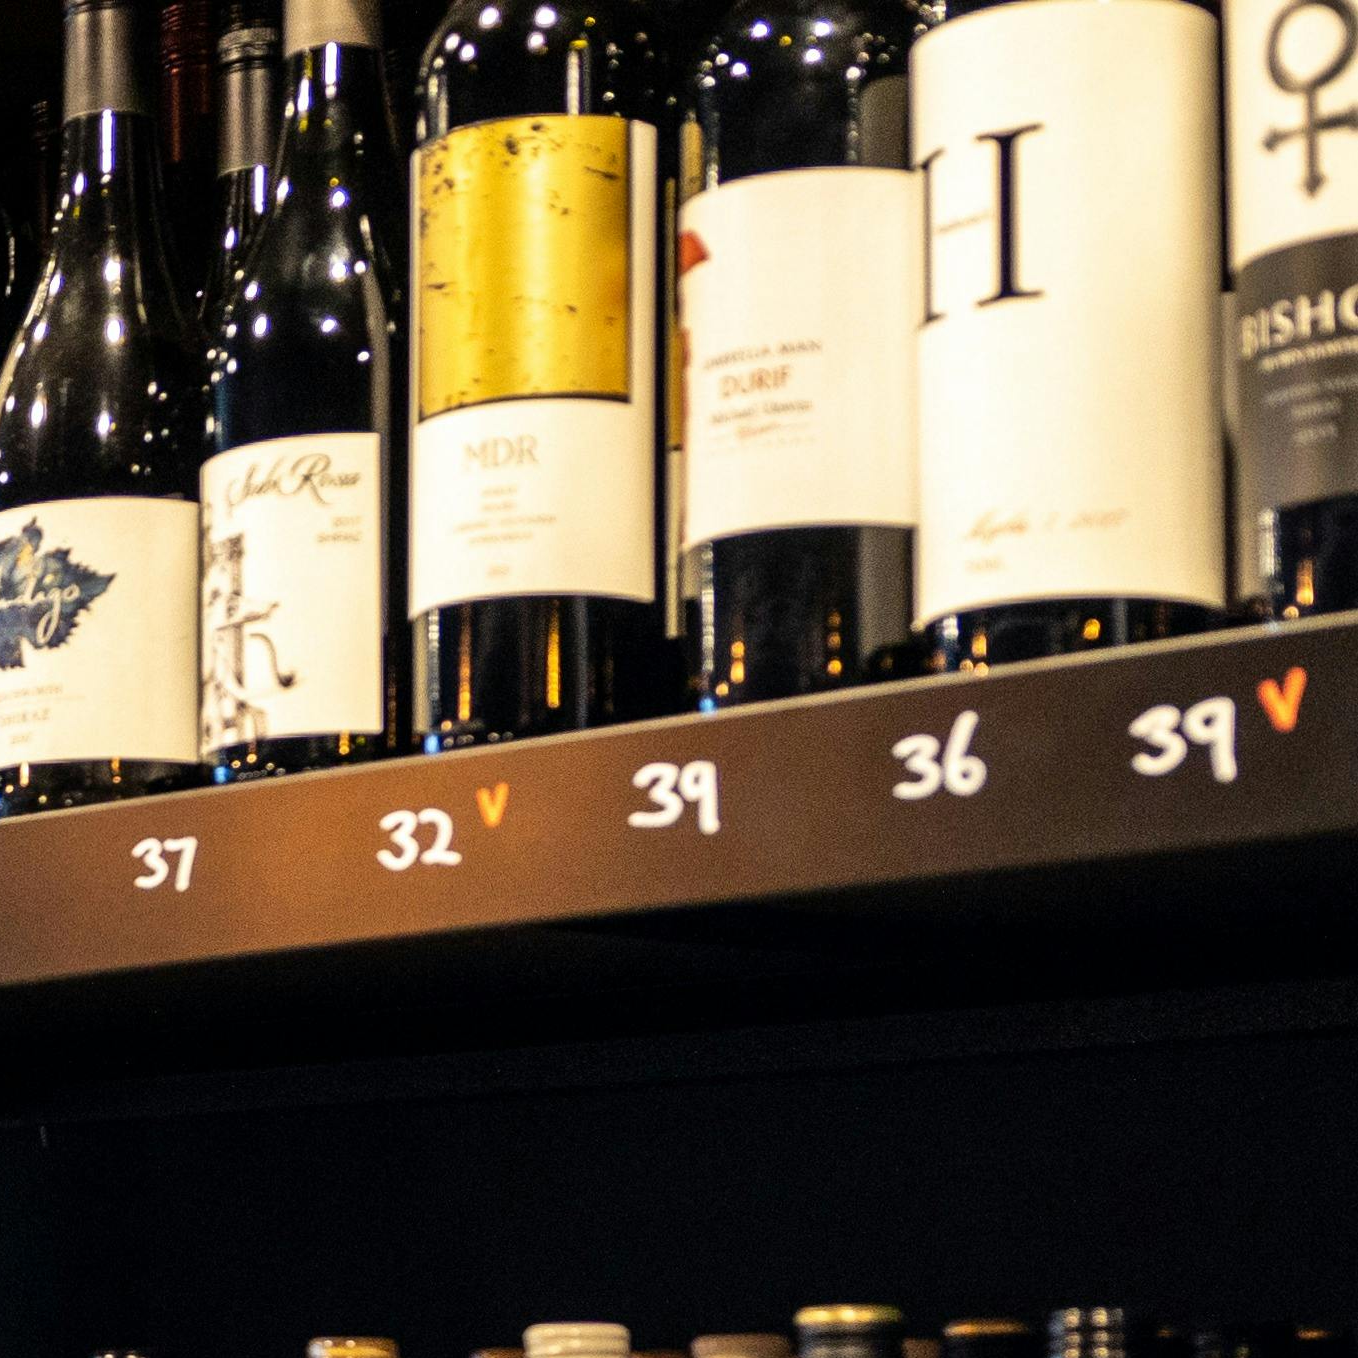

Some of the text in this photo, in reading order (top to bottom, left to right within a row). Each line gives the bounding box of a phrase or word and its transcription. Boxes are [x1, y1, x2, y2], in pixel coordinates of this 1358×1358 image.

[892, 710, 988, 799] 36
[1128, 696, 1239, 784] 39
[628, 760, 720, 834] 39
[131, 836, 198, 891] 37
[376, 809, 462, 871] 32
